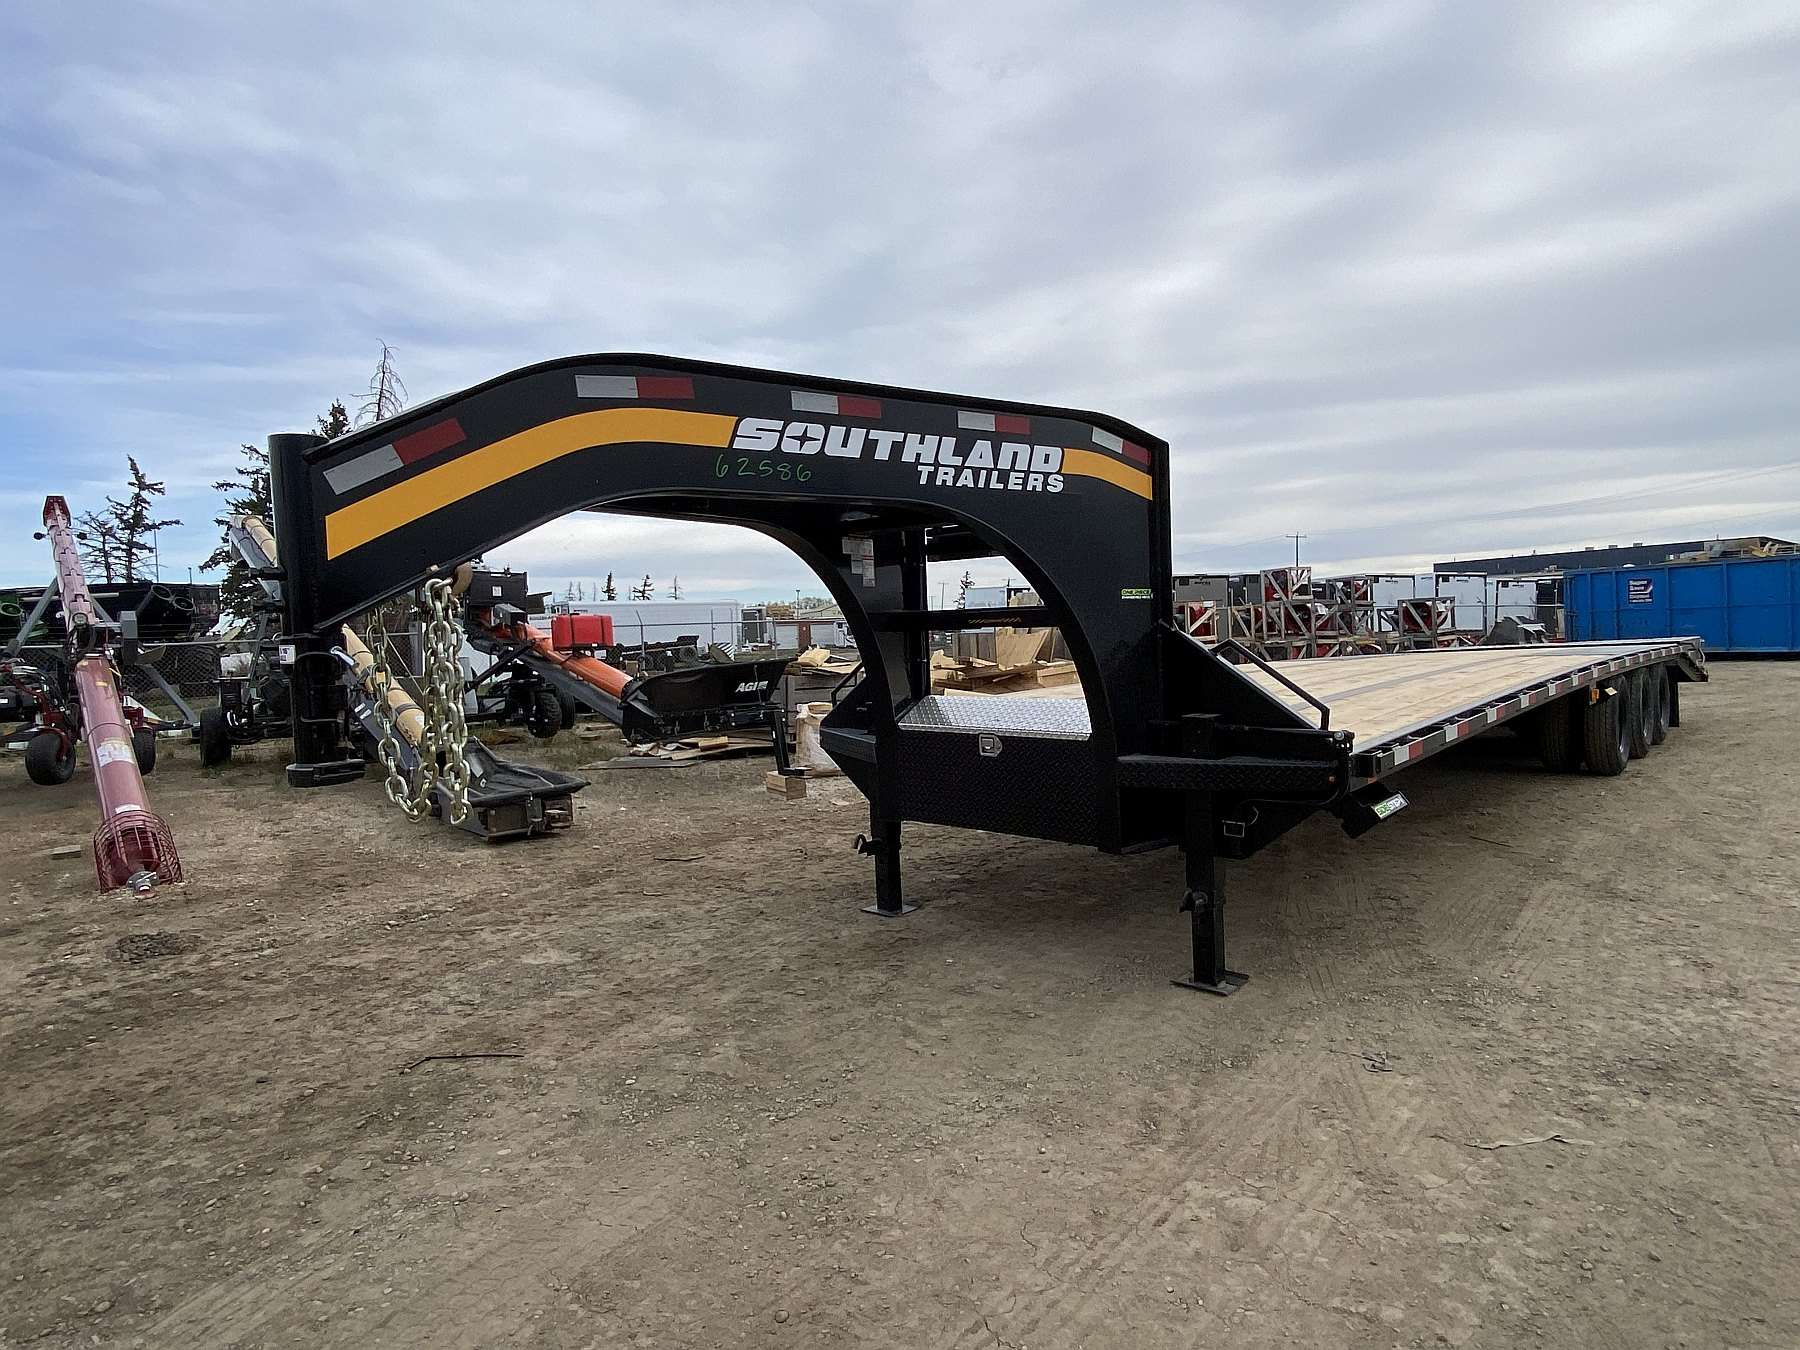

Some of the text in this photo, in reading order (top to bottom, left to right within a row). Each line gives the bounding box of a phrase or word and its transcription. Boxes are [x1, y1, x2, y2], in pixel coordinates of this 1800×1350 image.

[732, 417, 1063, 473] SOUTHLAND
[715, 454, 812, 482] 62586
[917, 465, 1064, 493] TRAILERS
[735, 682, 758, 693] AGI
